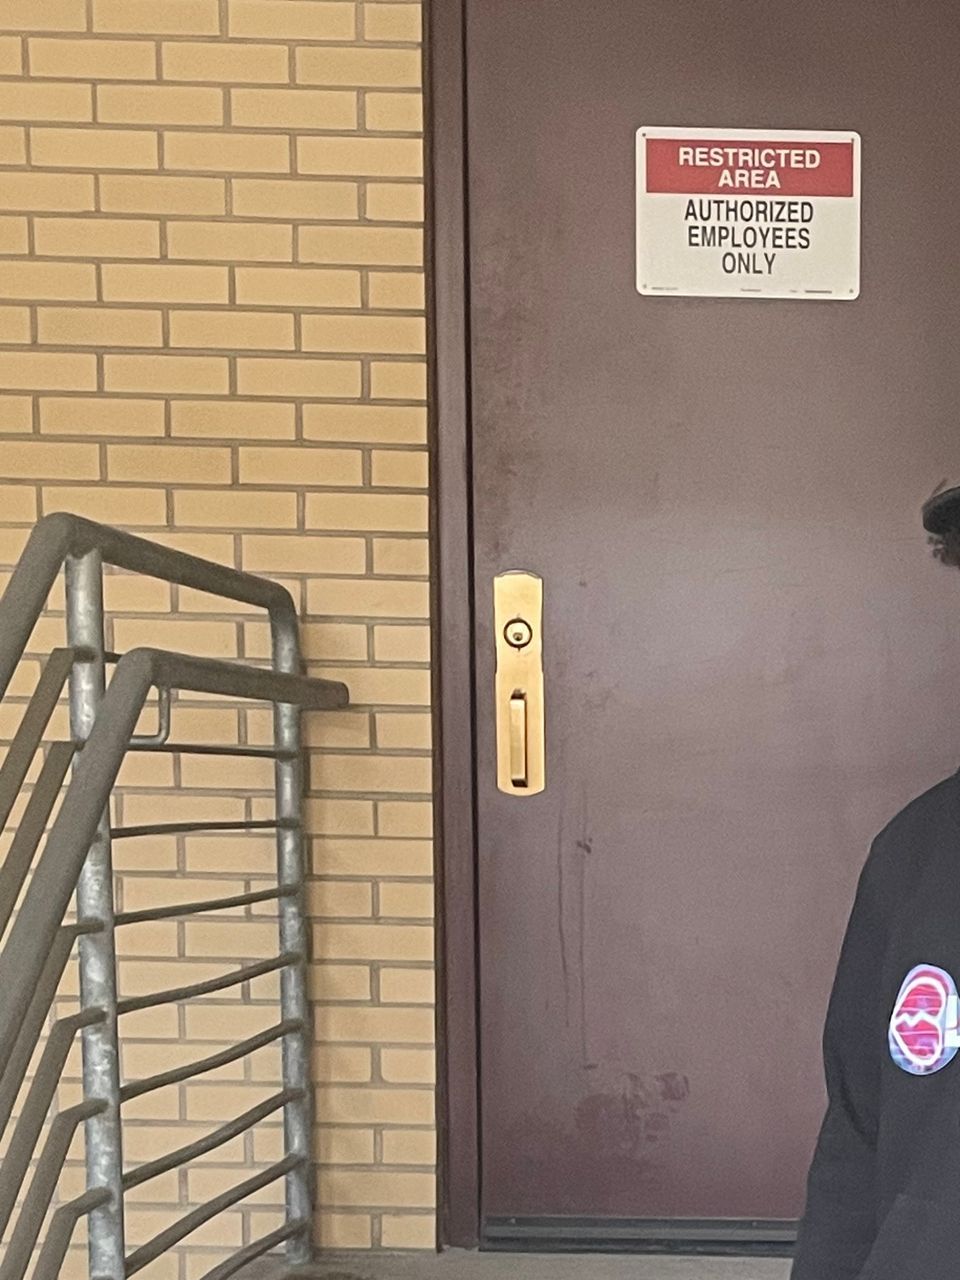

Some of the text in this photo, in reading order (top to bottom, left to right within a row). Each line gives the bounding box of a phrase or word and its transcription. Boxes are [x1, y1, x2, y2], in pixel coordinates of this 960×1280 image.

[678, 147, 821, 168] RESTRICTED
[718, 169, 781, 188] AREA
[684, 199, 814, 223] AUTHORIZED
[688, 226, 810, 249] EMPLOYEES
[722, 252, 776, 275] ONLY
